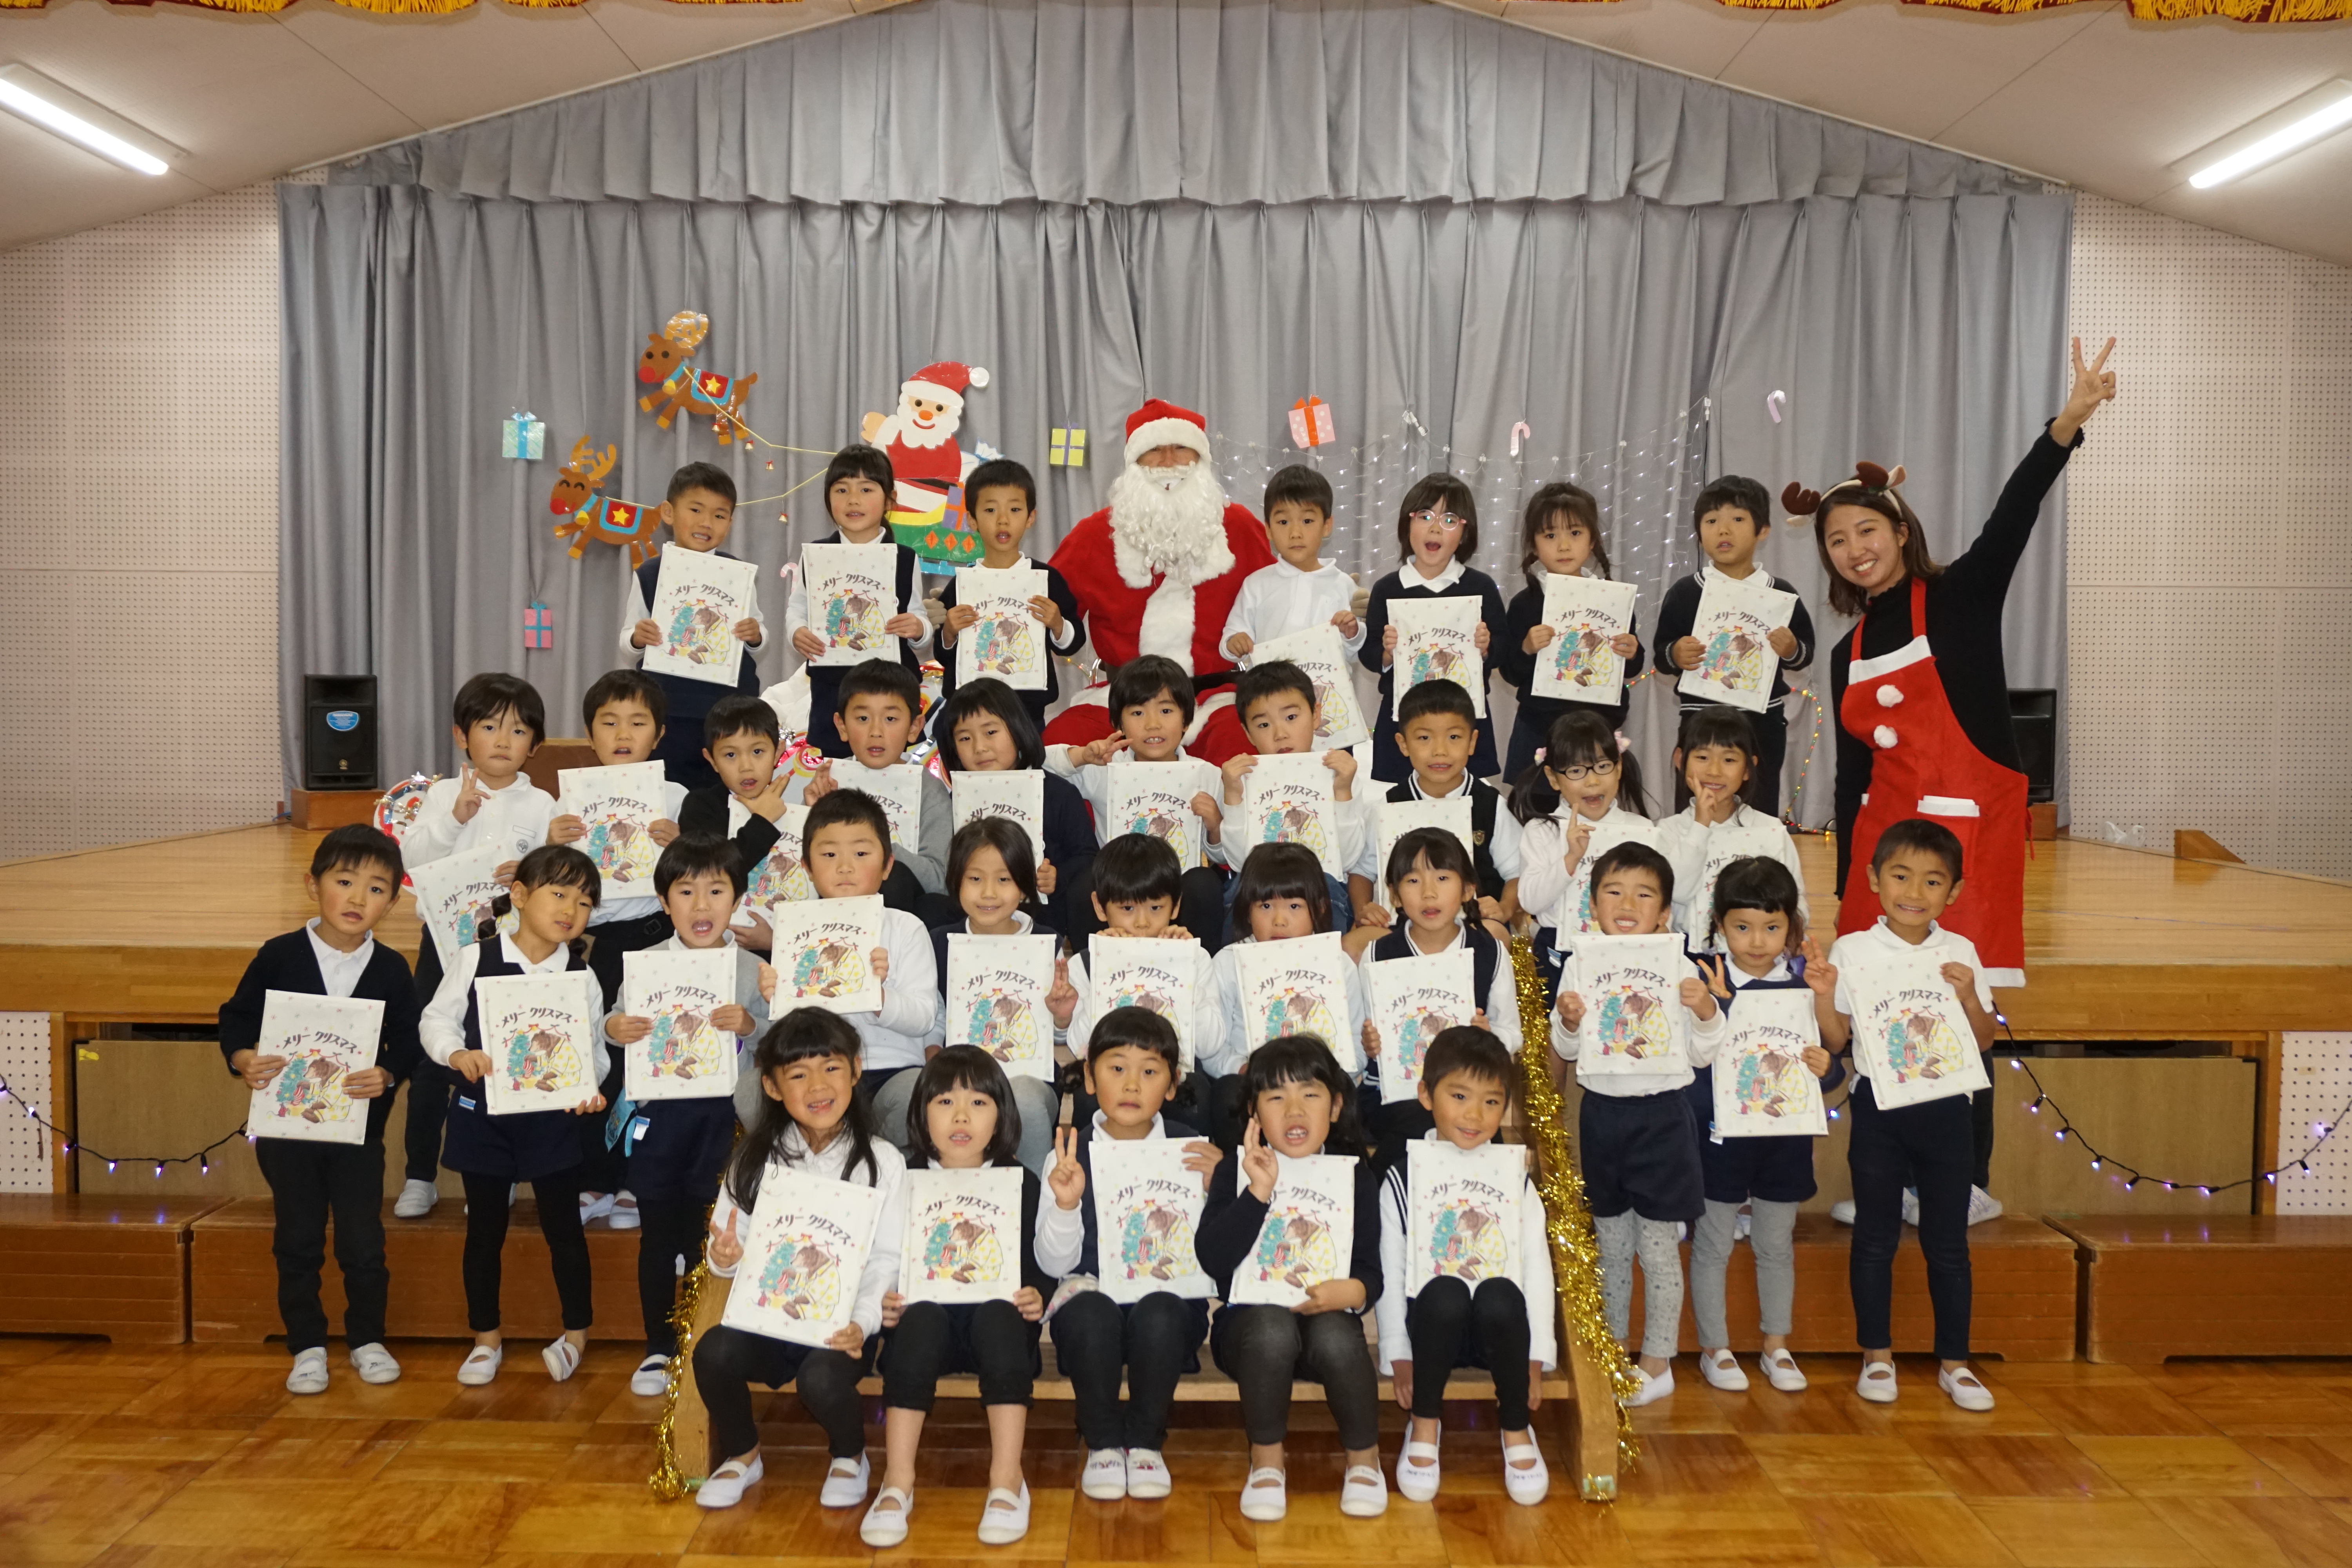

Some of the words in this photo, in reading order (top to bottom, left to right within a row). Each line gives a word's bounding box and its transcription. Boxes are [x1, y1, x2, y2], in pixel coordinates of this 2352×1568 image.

[822, 577, 843, 591] メリー
[846, 573, 881, 590] クリスマス
[675, 584, 698, 597] メリー
[700, 583, 735, 606] クリスマス
[1560, 610, 1582, 622] メリー
[1584, 608, 1618, 628] クリスマス
[1713, 611, 1737, 622] メリー
[1738, 612, 1771, 635] クリスマス
[1408, 631, 1428, 646] メリー
[1431, 628, 1466, 642] クリスマス
[1126, 796, 1148, 810] メリー
[1151, 792, 1186, 809] クリスマス
[1259, 789, 1280, 805] メリー
[1283, 785, 1320, 800] クリスマス
[583, 801, 605, 818] メリー
[608, 797, 647, 813] クリスマス
[970, 808, 989, 822] メリー
[992, 803, 1026, 820] クリスマス
[1706, 857, 1728, 873] メリー
[443, 891, 463, 912] メリー
[793, 928, 818, 945] メリー
[821, 922, 862, 935] クリスマス
[967, 974, 991, 991] メリー
[994, 970, 1035, 989] クリスマス
[1109, 970, 1134, 986] メリー
[1138, 966, 1178, 987] クリスマス
[1259, 975, 1282, 995] メリー
[1285, 969, 1326, 985] クリスマス
[1595, 972, 1619, 988] メリー
[1623, 967, 1666, 987] クリスマス
[646, 990, 671, 1008] メリー
[674, 985, 716, 1004] クリスマス
[1391, 993, 1414, 1013] メリー
[1417, 988, 1459, 1004] クリスマス
[1873, 997, 1895, 1018] メリー
[1899, 989, 1942, 1002] クリスマス
[502, 1011, 526, 1028] メリー
[530, 1007, 572, 1023] クリスマス
[283, 1034, 311, 1049] メリー
[314, 1031, 358, 1053] クリスマス
[1731, 1030, 1756, 1047] メリー
[1759, 1025, 1801, 1044] クリスマス
[1116, 1183, 1142, 1205] メリー
[1146, 1178, 1191, 1198] クリスマス
[1291, 1186, 1336, 1211] クリスマス
[1430, 1181, 1457, 1200] メリー
[1461, 1178, 1505, 1203] クリスマス
[925, 1199, 951, 1216] メリー
[955, 1194, 1000, 1215] クリスマス
[773, 1214, 804, 1229] メリー
[806, 1214, 852, 1245] クリスマス
